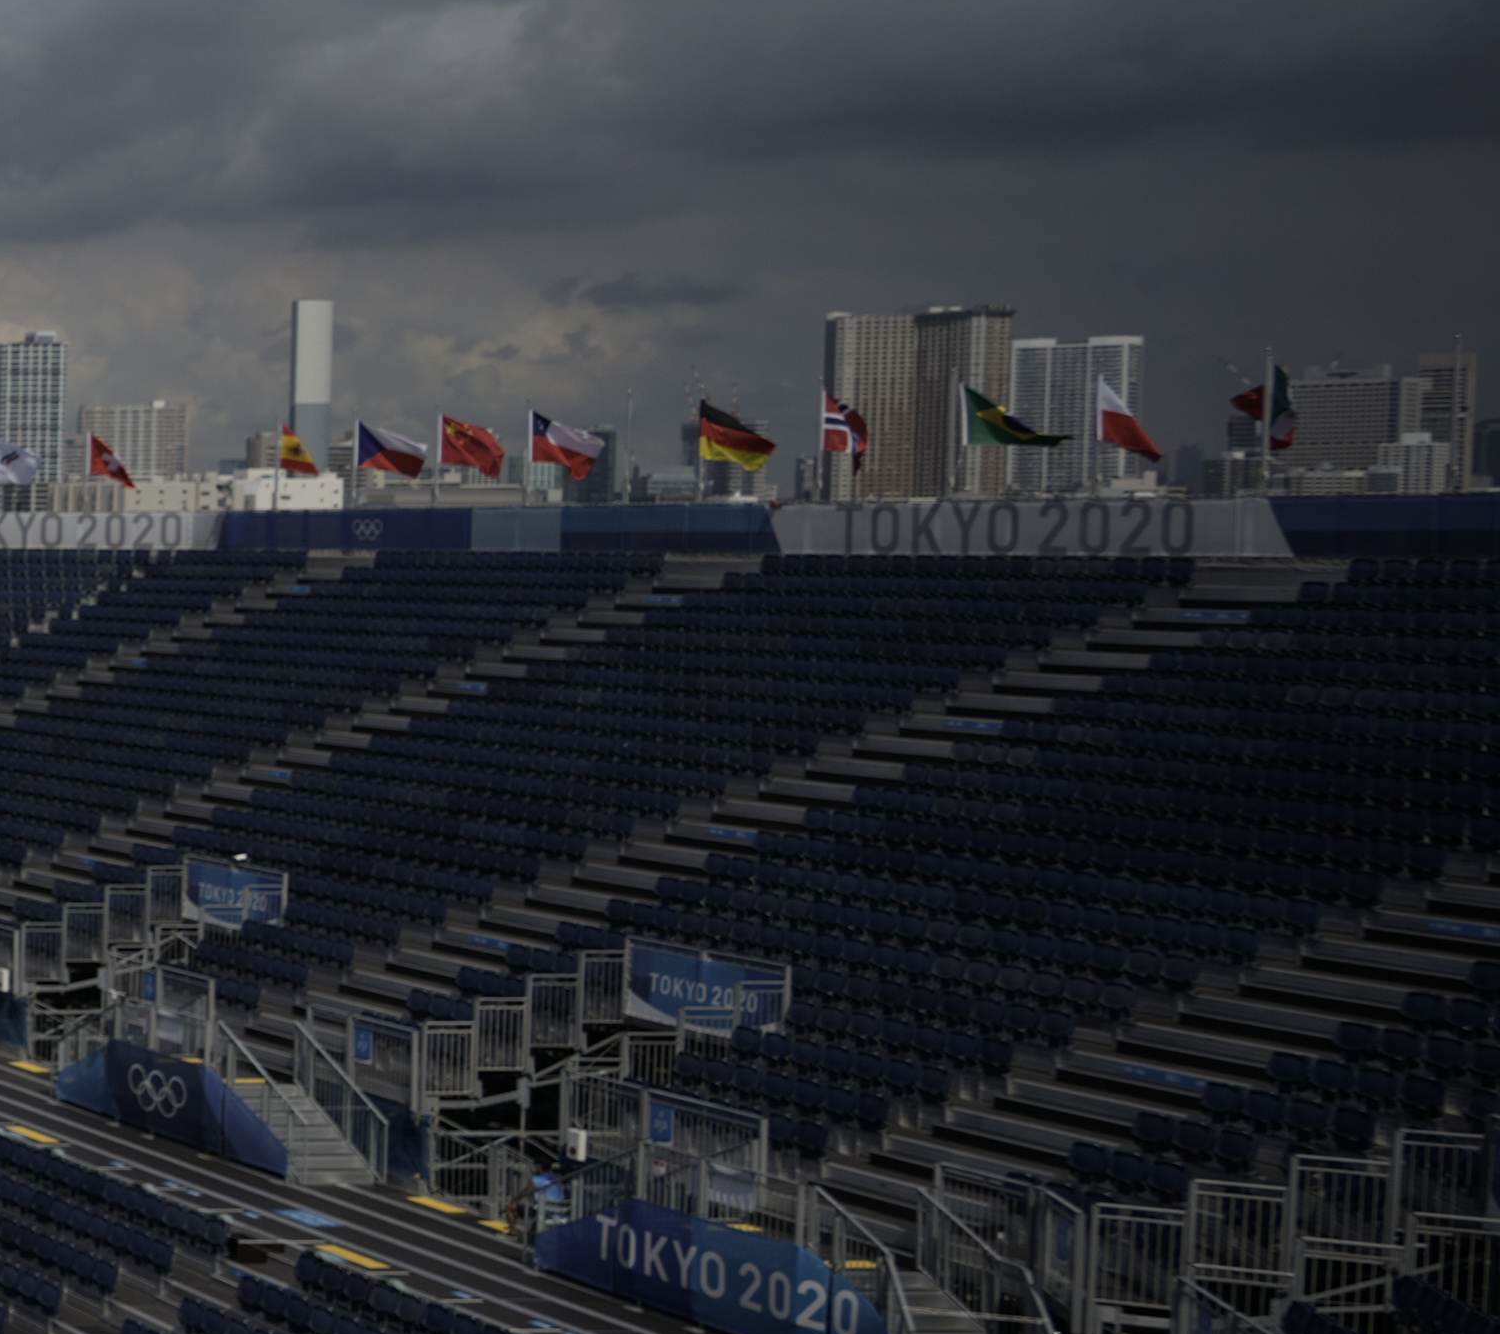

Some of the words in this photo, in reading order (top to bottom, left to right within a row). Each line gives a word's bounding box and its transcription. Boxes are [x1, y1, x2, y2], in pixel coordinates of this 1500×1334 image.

[76, 512, 181, 549] 2020
[836, 500, 1019, 555] TOKYO
[1038, 500, 1194, 555] 2020
[649, 971, 707, 1003] TOKYO
[596, 1212, 726, 1299] TOKYO
